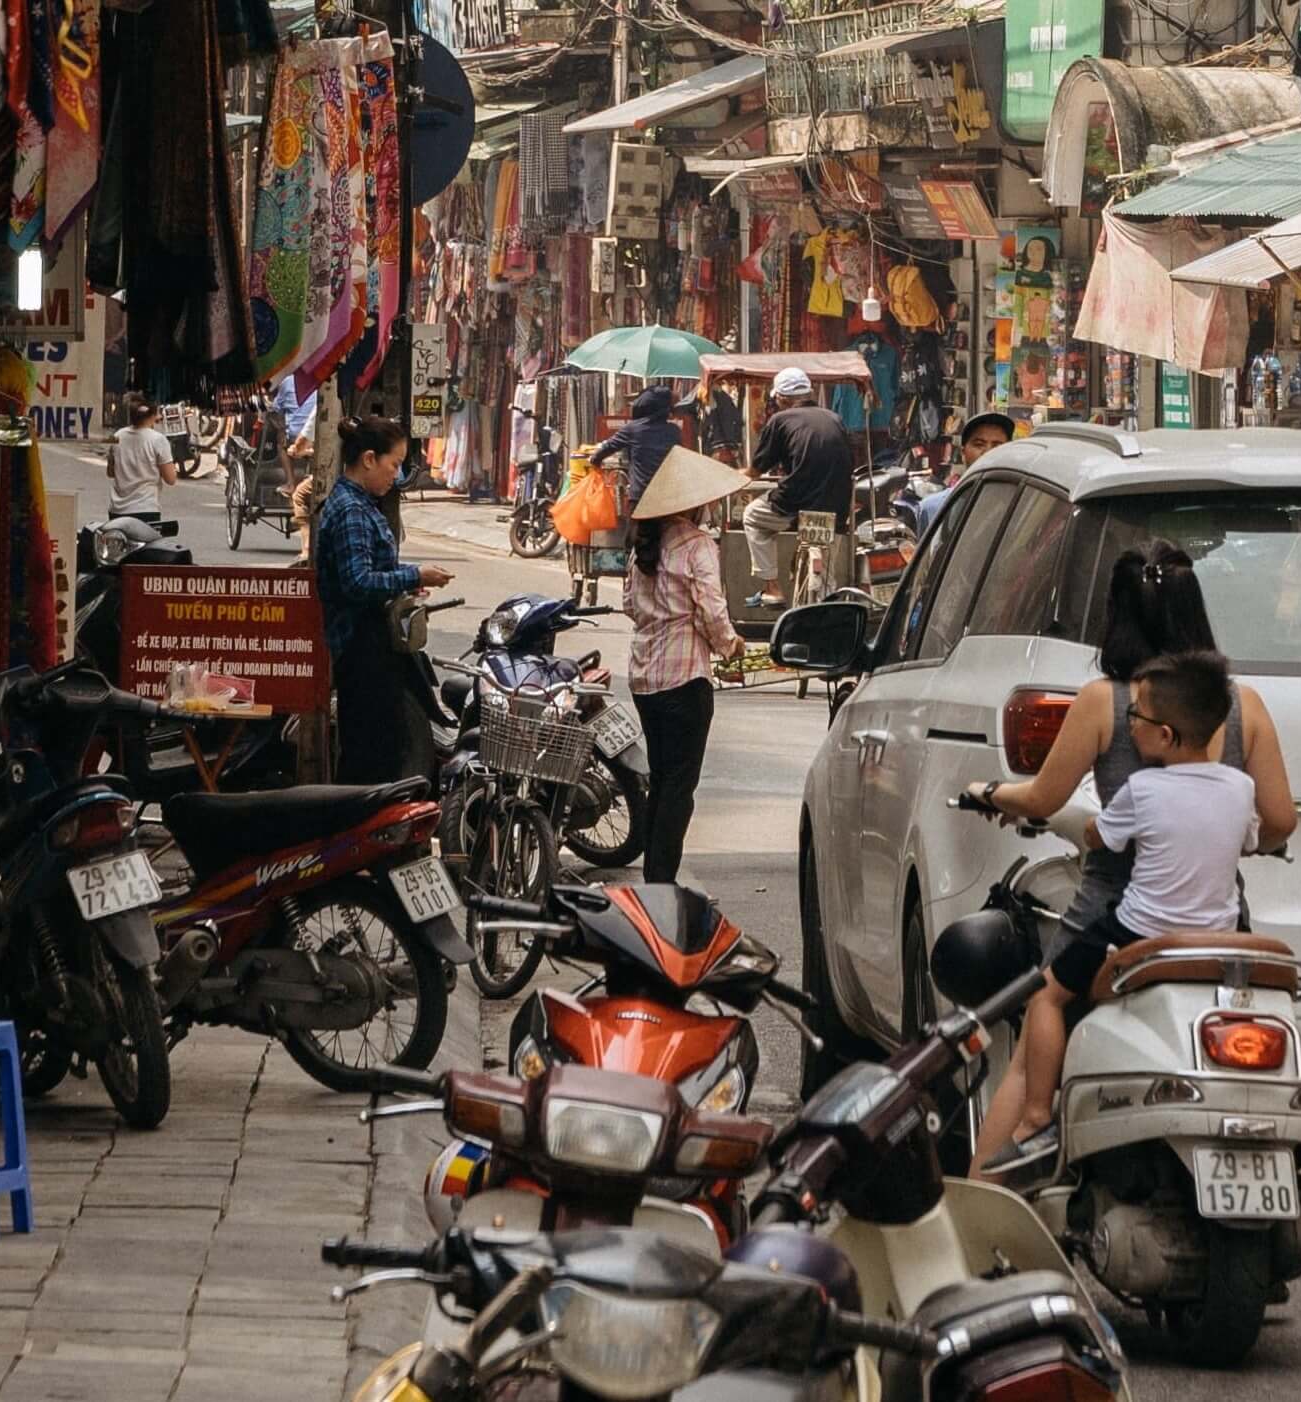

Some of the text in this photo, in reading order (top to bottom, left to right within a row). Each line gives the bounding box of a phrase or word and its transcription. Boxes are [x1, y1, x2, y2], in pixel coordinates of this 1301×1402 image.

[415, 399, 440, 409] 420
[143, 576, 310, 596] UBND QUẬN HOÀN KIẾM
[166, 600, 285, 622] TUYẾN PHỐ CẤM
[149, 636, 160, 648] XE
[180, 636, 191, 649] XE
[255, 854, 322, 887] Wave
[399, 861, 441, 893] 29-U5
[411, 885, 453, 916] 0101
[1210, 1152, 1279, 1181] 29-B1
[1206, 1184, 1292, 1213] 157.80
